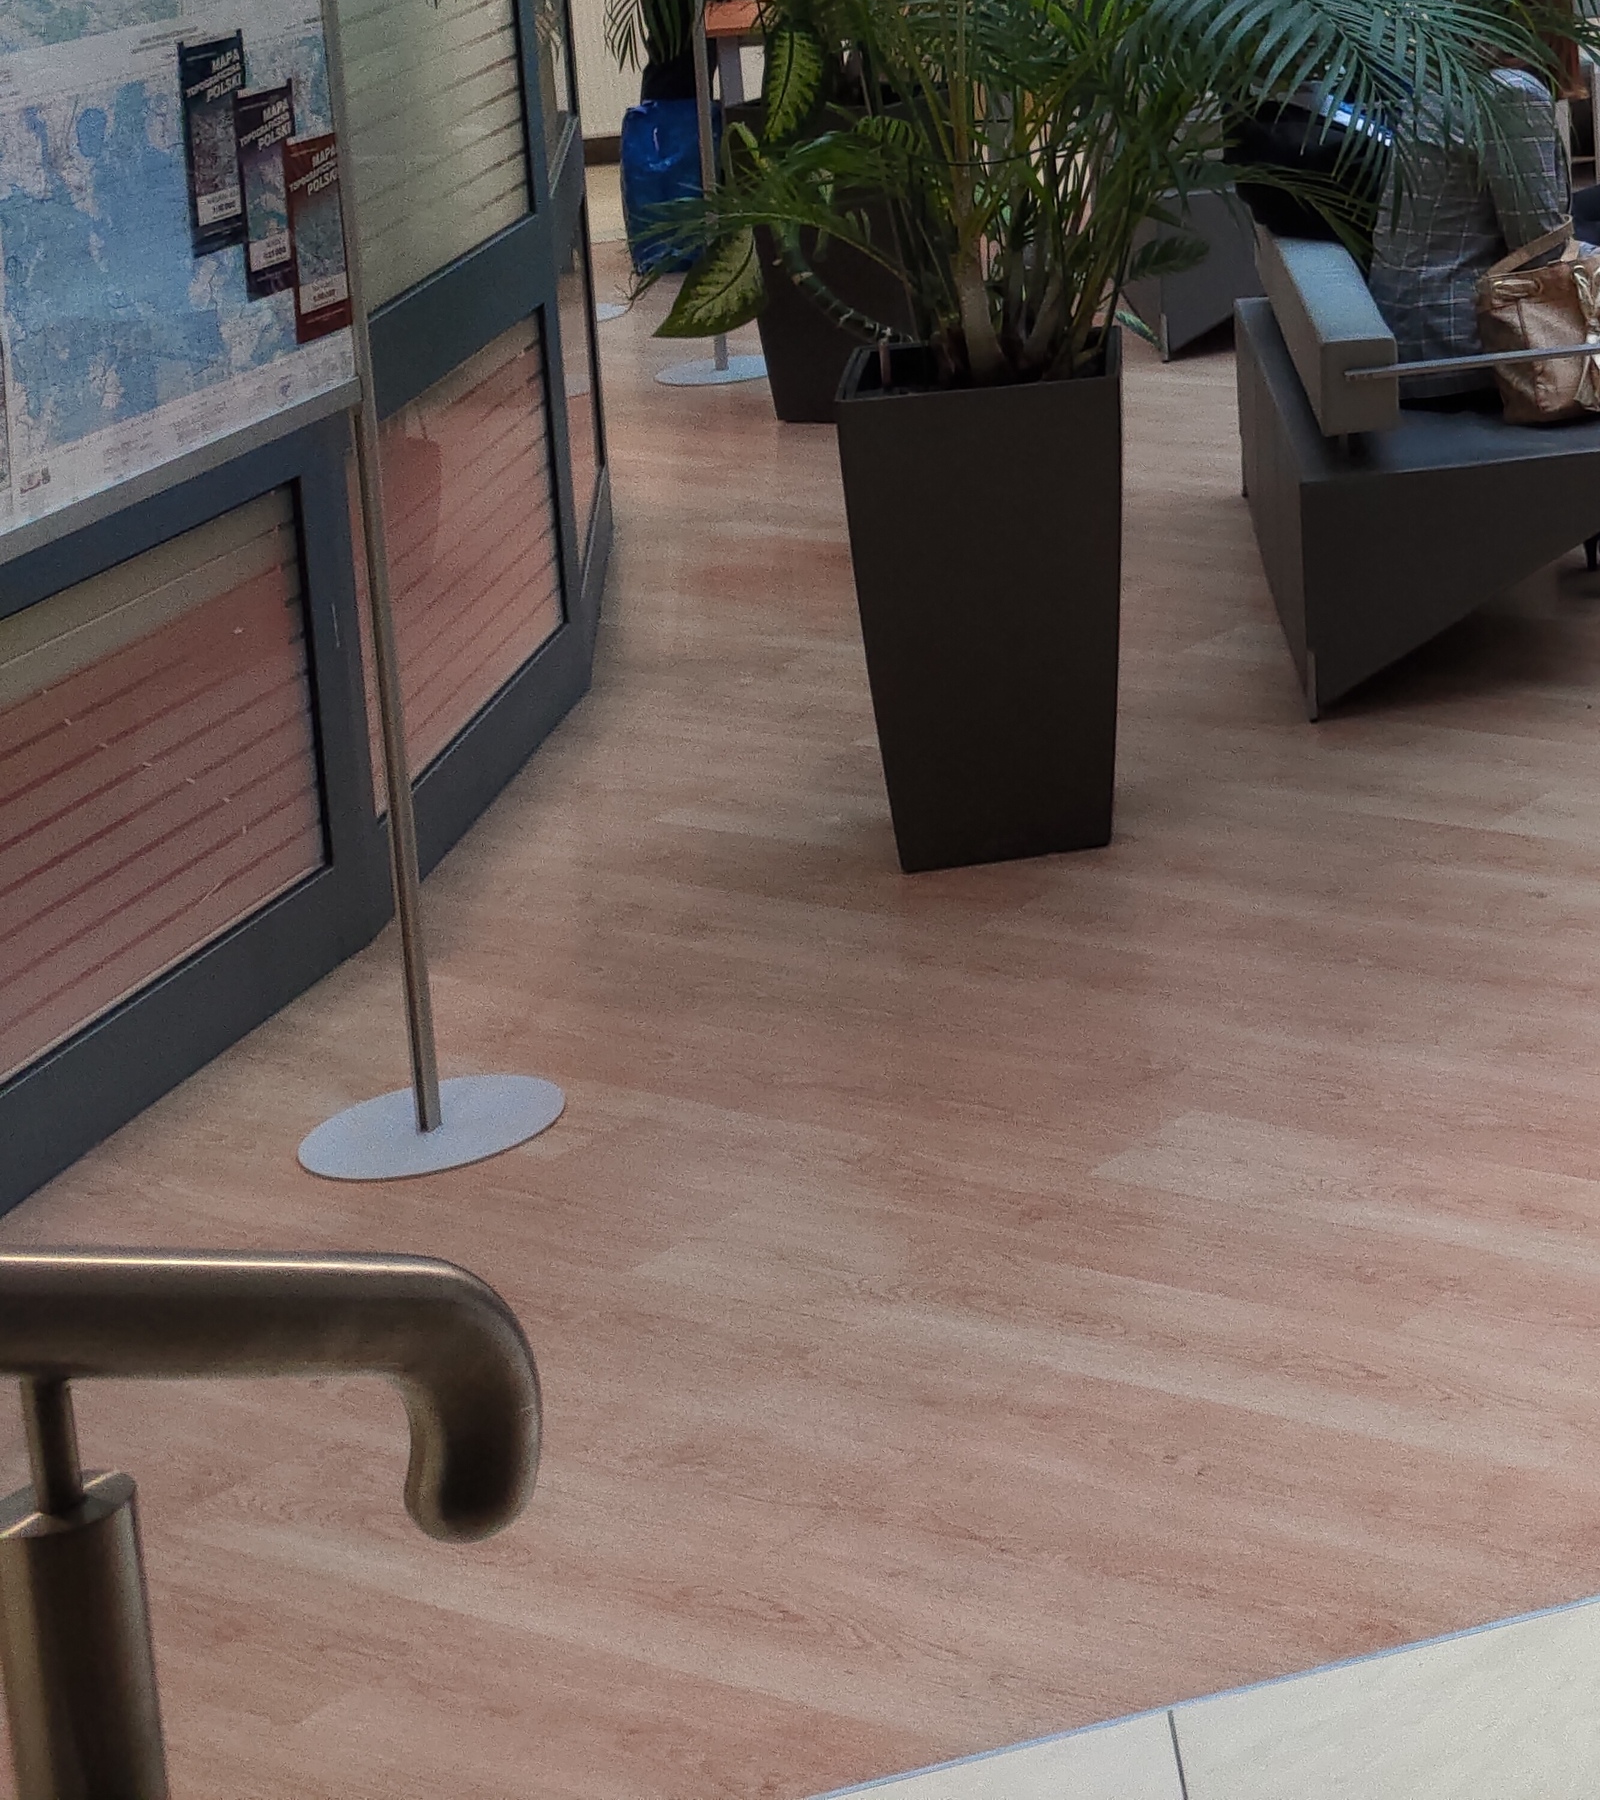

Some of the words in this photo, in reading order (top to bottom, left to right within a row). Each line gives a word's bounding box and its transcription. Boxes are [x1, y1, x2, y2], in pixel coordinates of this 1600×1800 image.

[211, 48, 240, 74] MAPA
[206, 73, 242, 103] POLSKI
[262, 98, 290, 122] MAPA
[257, 121, 292, 151] POLSKI
